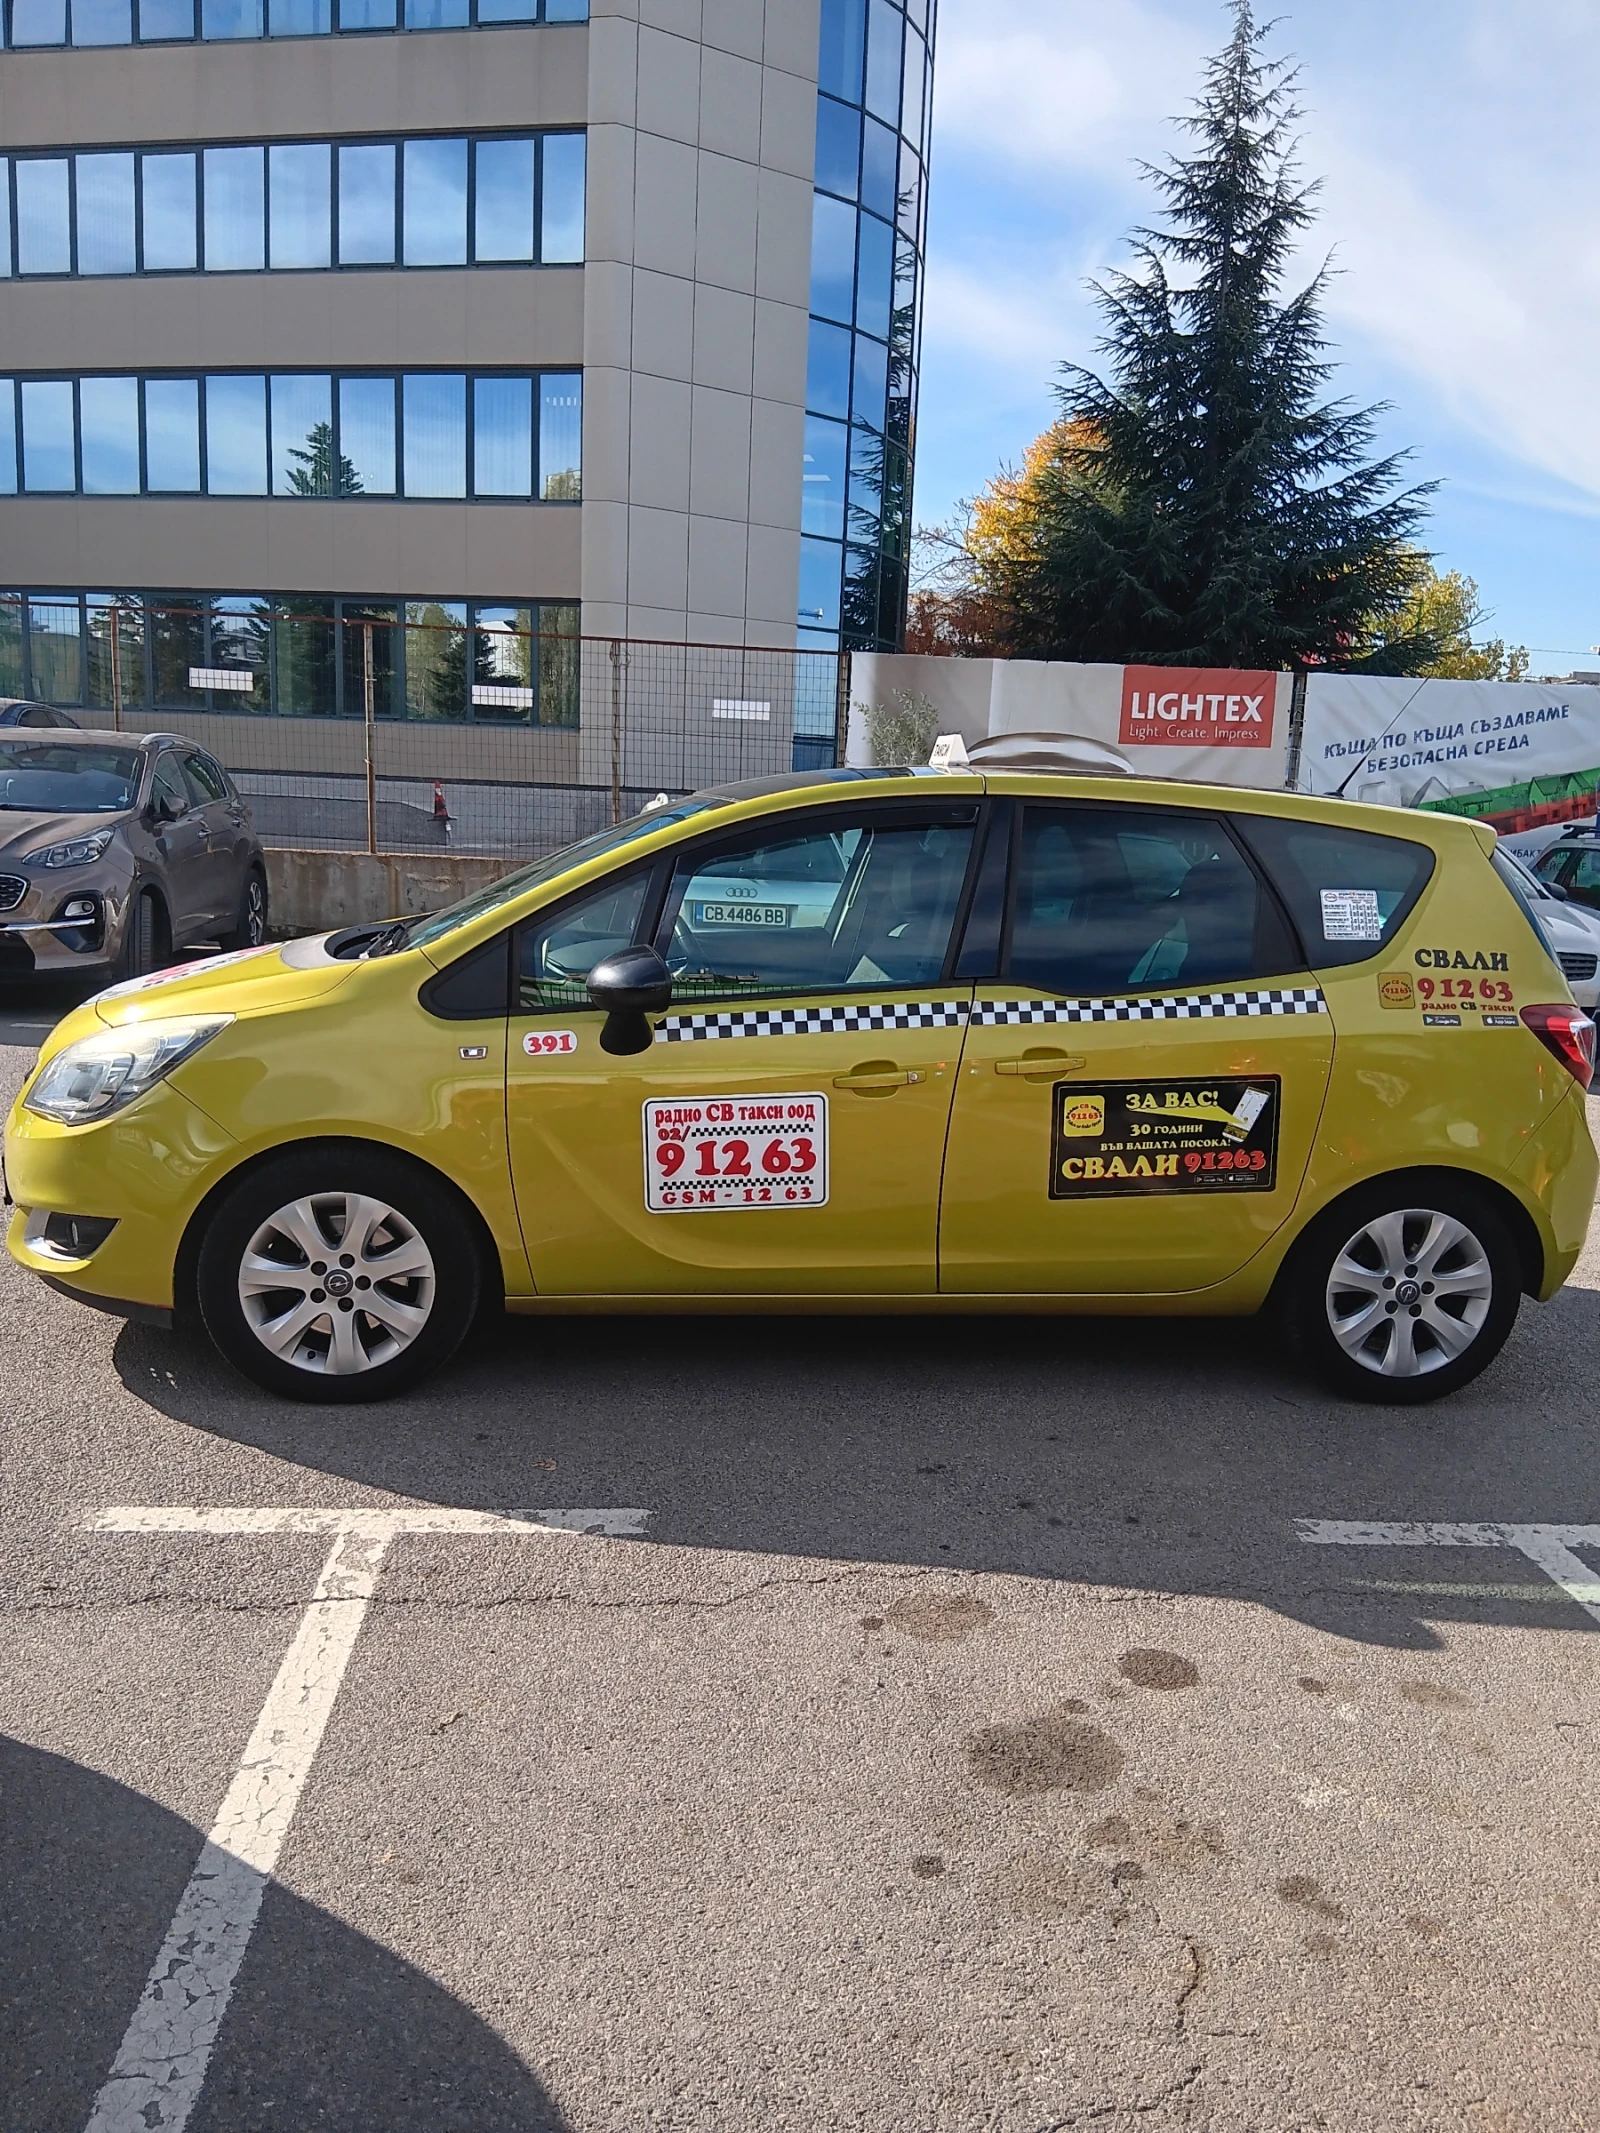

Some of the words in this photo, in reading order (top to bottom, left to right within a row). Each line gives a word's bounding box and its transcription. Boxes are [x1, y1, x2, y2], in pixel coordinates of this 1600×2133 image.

[1130, 691, 1264, 723] LIGHTEX
[1129, 723, 1162, 740] Light.
[1166, 724, 1210, 739] Create.
[1215, 725, 1262, 743] Impress.
[1324, 737, 1377, 759] КЪЩА
[1383, 733, 1406, 750] ПО
[1413, 722, 1464, 744] КЪЩА
[1470, 704, 1570, 735] СЪЗДАВАМЕ
[1367, 744, 1468, 773] БЕЗОПАСНА
[1474, 734, 1530, 756] СРЕДА
[1414, 948, 1509, 972] СВАЛИ
[1421, 1002, 1457, 1011] радио
[1460, 1001, 1477, 1010] СВ
[1480, 1004, 1515, 1012] такси
[527, 1034, 573, 1053] 391
[1125, 1093, 1159, 1109] ЗА
[1165, 1090, 1219, 1108] ВАС!
[655, 1107, 701, 1128] радио
[706, 1103, 735, 1122] СВ
[739, 1104, 784, 1121] такси
[787, 1103, 816, 1123] оод
[657, 1125, 691, 1143] 02/
[1130, 1124, 1151, 1137] 30
[1154, 1124, 1204, 1135] ГОДИНИ
[1100, 1142, 1124, 1151] ВЪВ
[1126, 1140, 1177, 1151] ВАШАТА
[1180, 1138, 1231, 1149] ПОСОКА!
[1061, 1153, 1181, 1180] СВАЛИ
[1184, 1149, 1267, 1173] 91263
